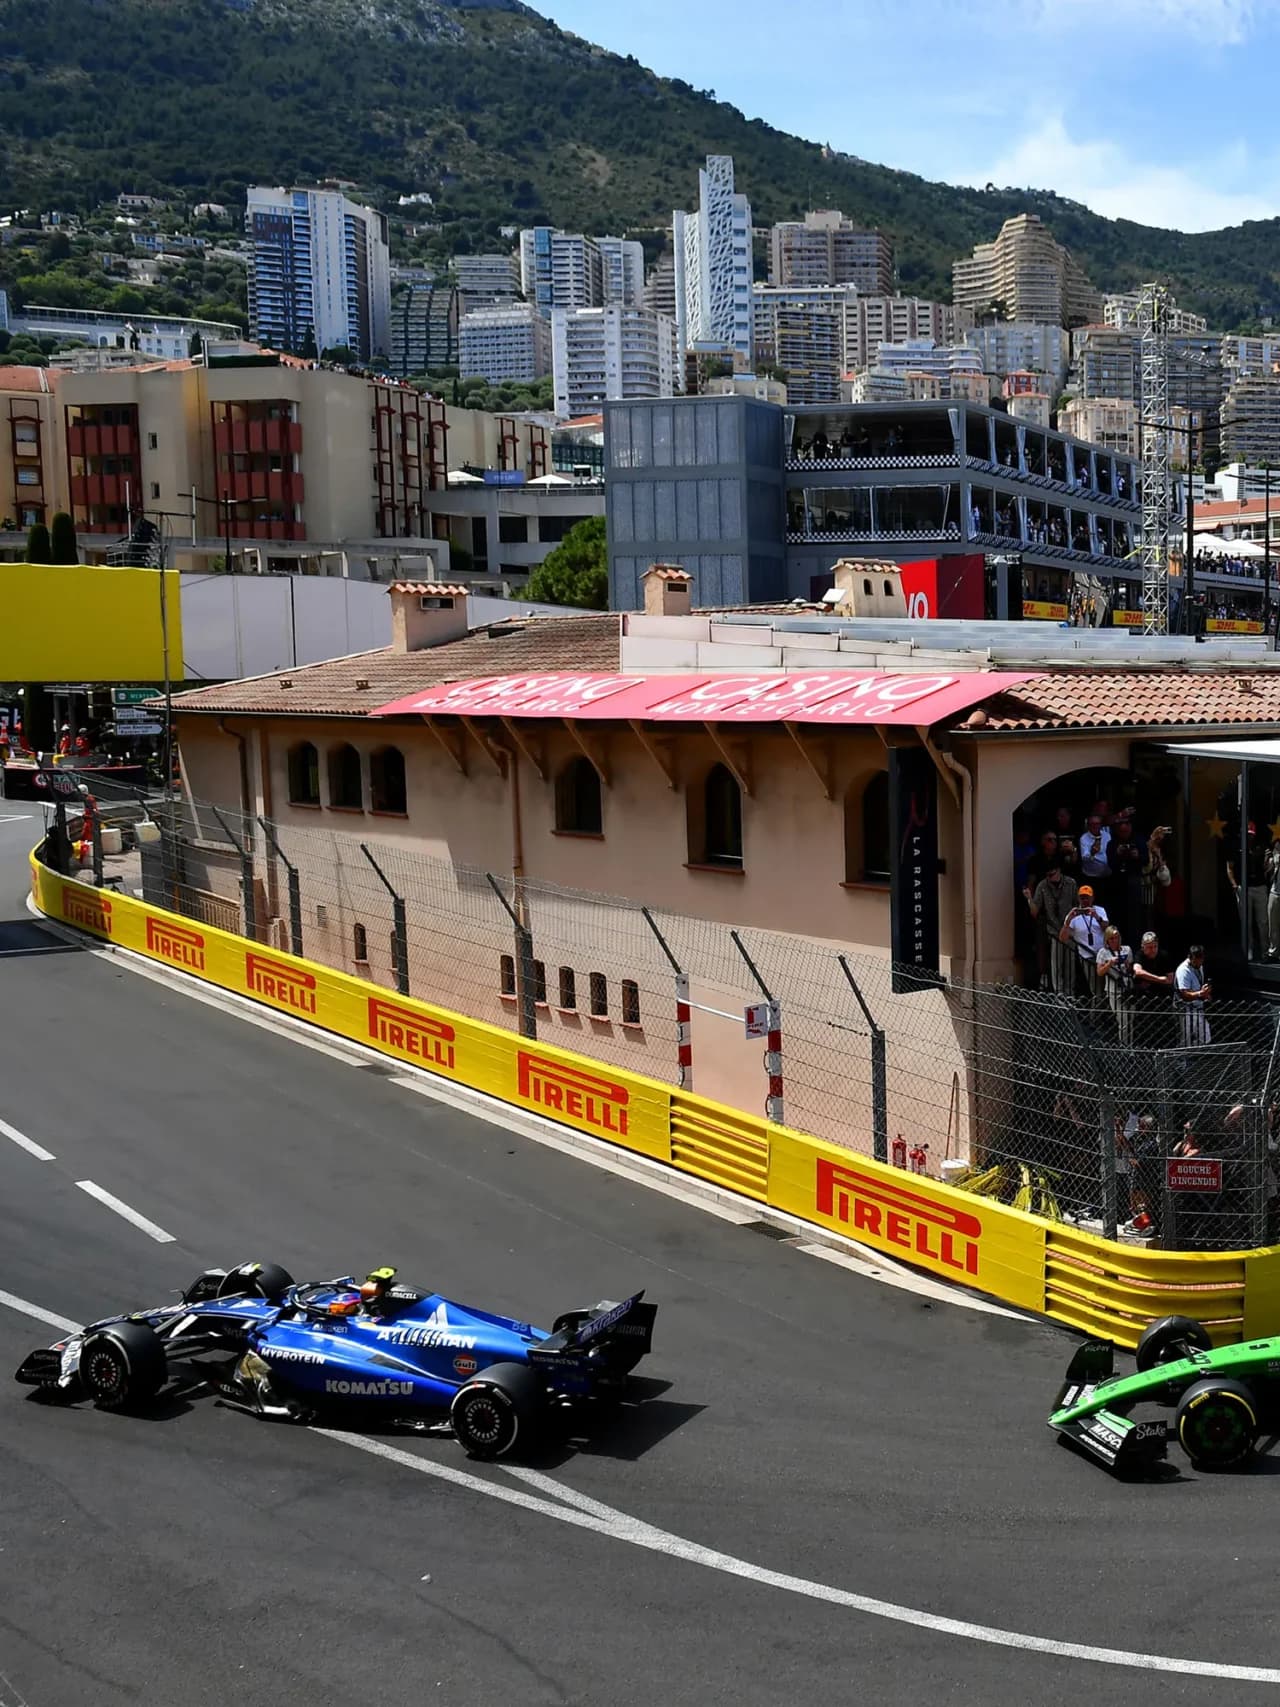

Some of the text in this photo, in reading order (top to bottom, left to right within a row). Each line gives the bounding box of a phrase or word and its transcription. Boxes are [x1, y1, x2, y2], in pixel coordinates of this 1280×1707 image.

[447, 675, 647, 701] CASINO
[690, 675, 954, 702] CASINO
[63, 886, 112, 933] PIRELLI
[912, 836, 923, 963] LA RASCASSE
[146, 916, 205, 970] PIRELLI
[246, 952, 316, 1014] PIRELLI
[368, 997, 455, 1069] PIRELLI
[517, 1050, 629, 1136] PIRELLI
[1171, 1176, 1217, 1185] D'INCENDIE
[1177, 1165, 1212, 1175] BOUCHE
[816, 1157, 982, 1276] PIRELLI
[260, 1347, 326, 1365] MYPROTEIN
[452, 1358, 478, 1370] Gulf
[326, 1377, 414, 1396] KOMATSU
[1136, 1422, 1167, 1441] Stake
